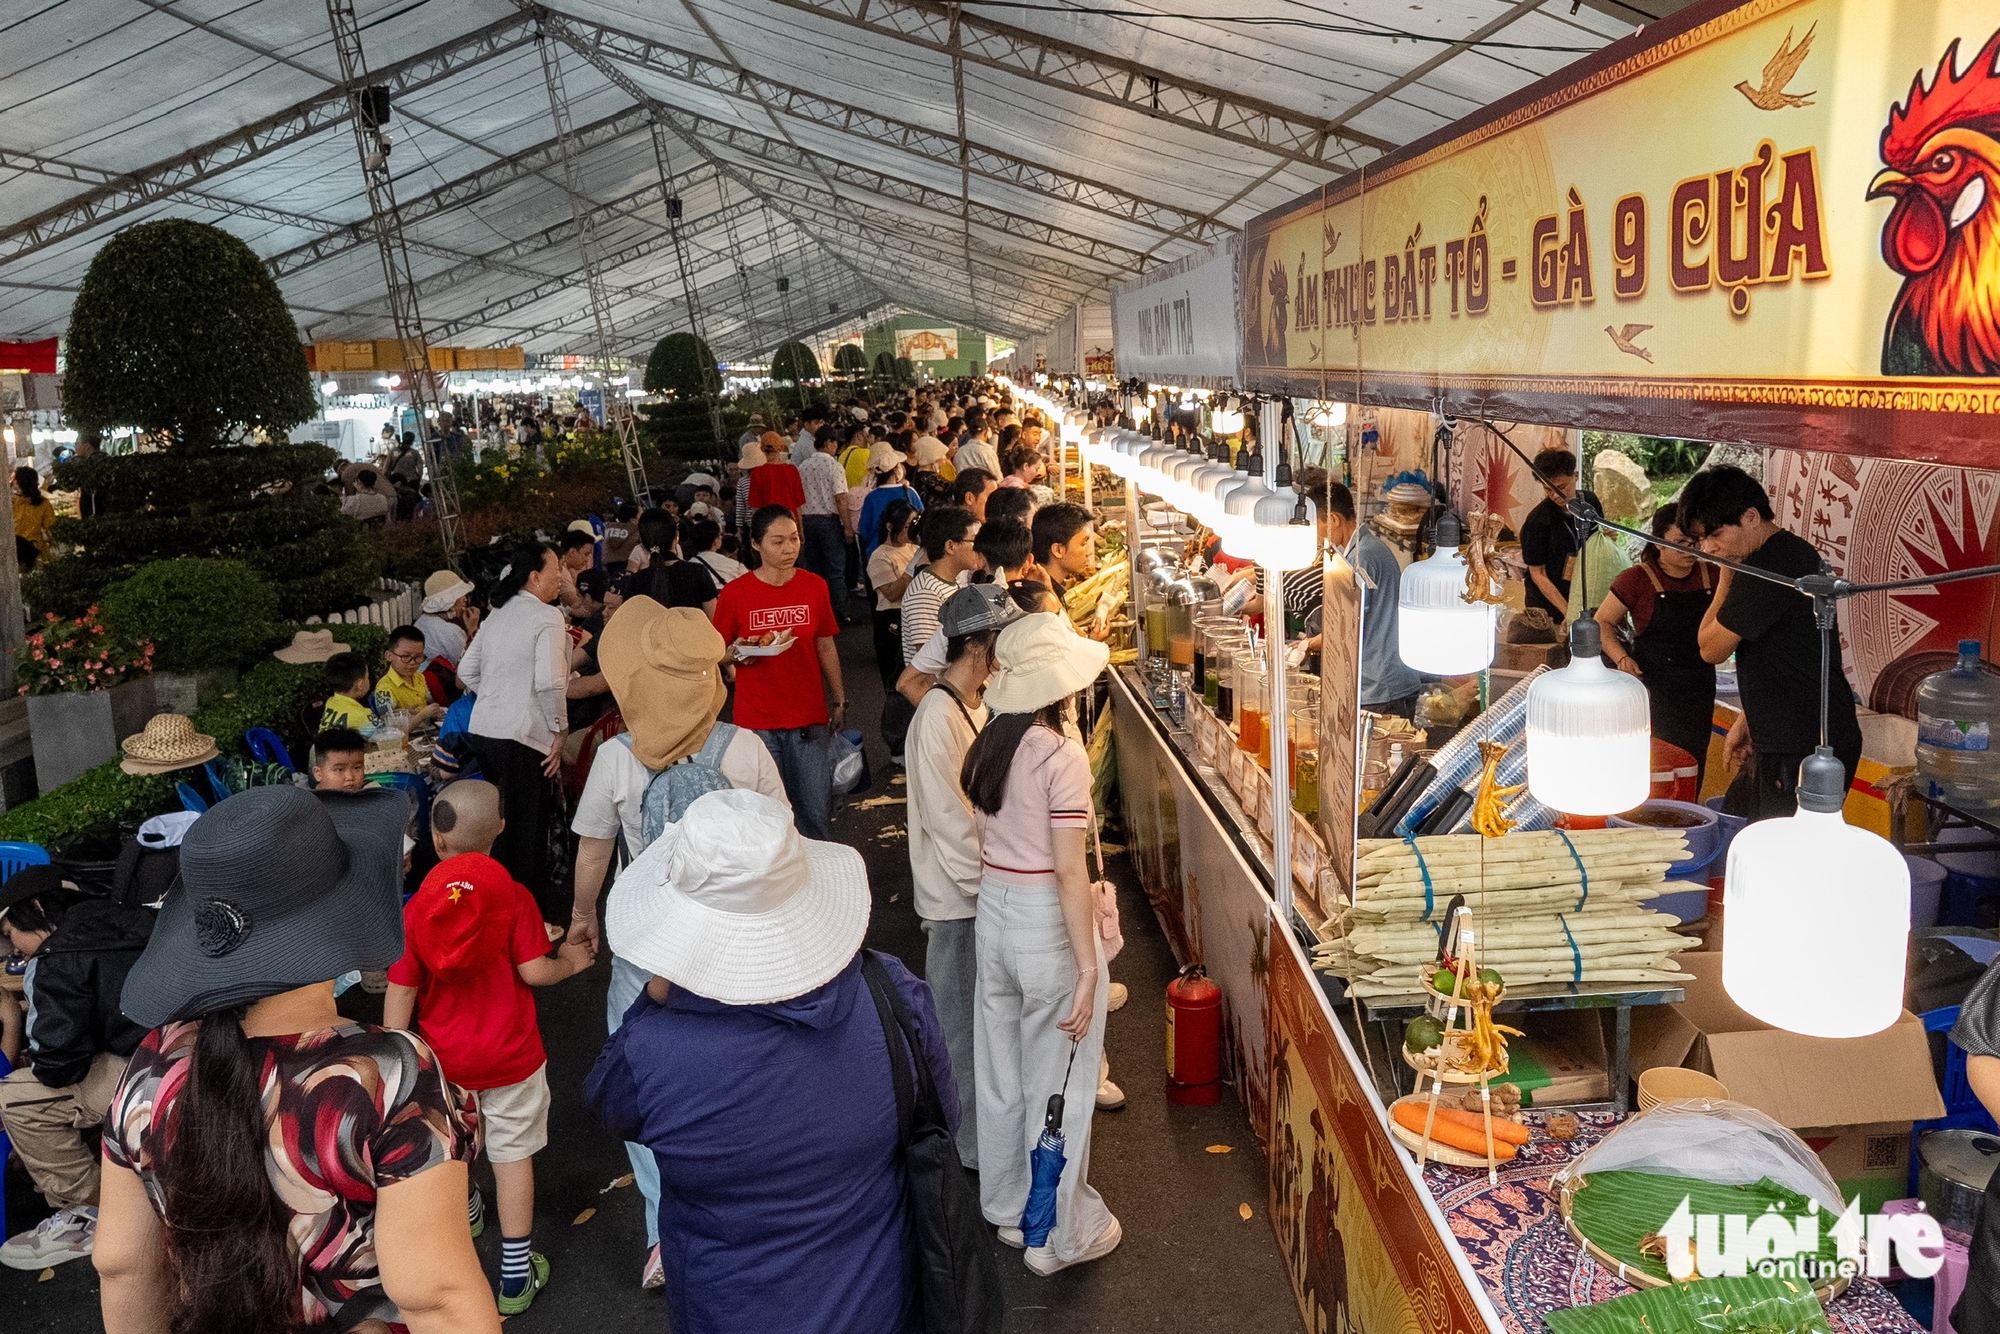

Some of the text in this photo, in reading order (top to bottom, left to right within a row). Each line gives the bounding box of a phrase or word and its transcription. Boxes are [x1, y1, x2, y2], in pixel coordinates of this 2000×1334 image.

[1294, 251, 1319, 330] ẨM
[1324, 256, 1377, 339] THỰC
[1383, 220, 1438, 322] ĐẤT
[1445, 192, 1491, 318] TỔ
[1530, 182, 1596, 306] GÀ
[1612, 192, 1647, 298] 9
[1668, 137, 1833, 316] CỰA
[1173, 289, 1195, 355] TRÀ
[752, 606, 807, 628] LEVI'S
